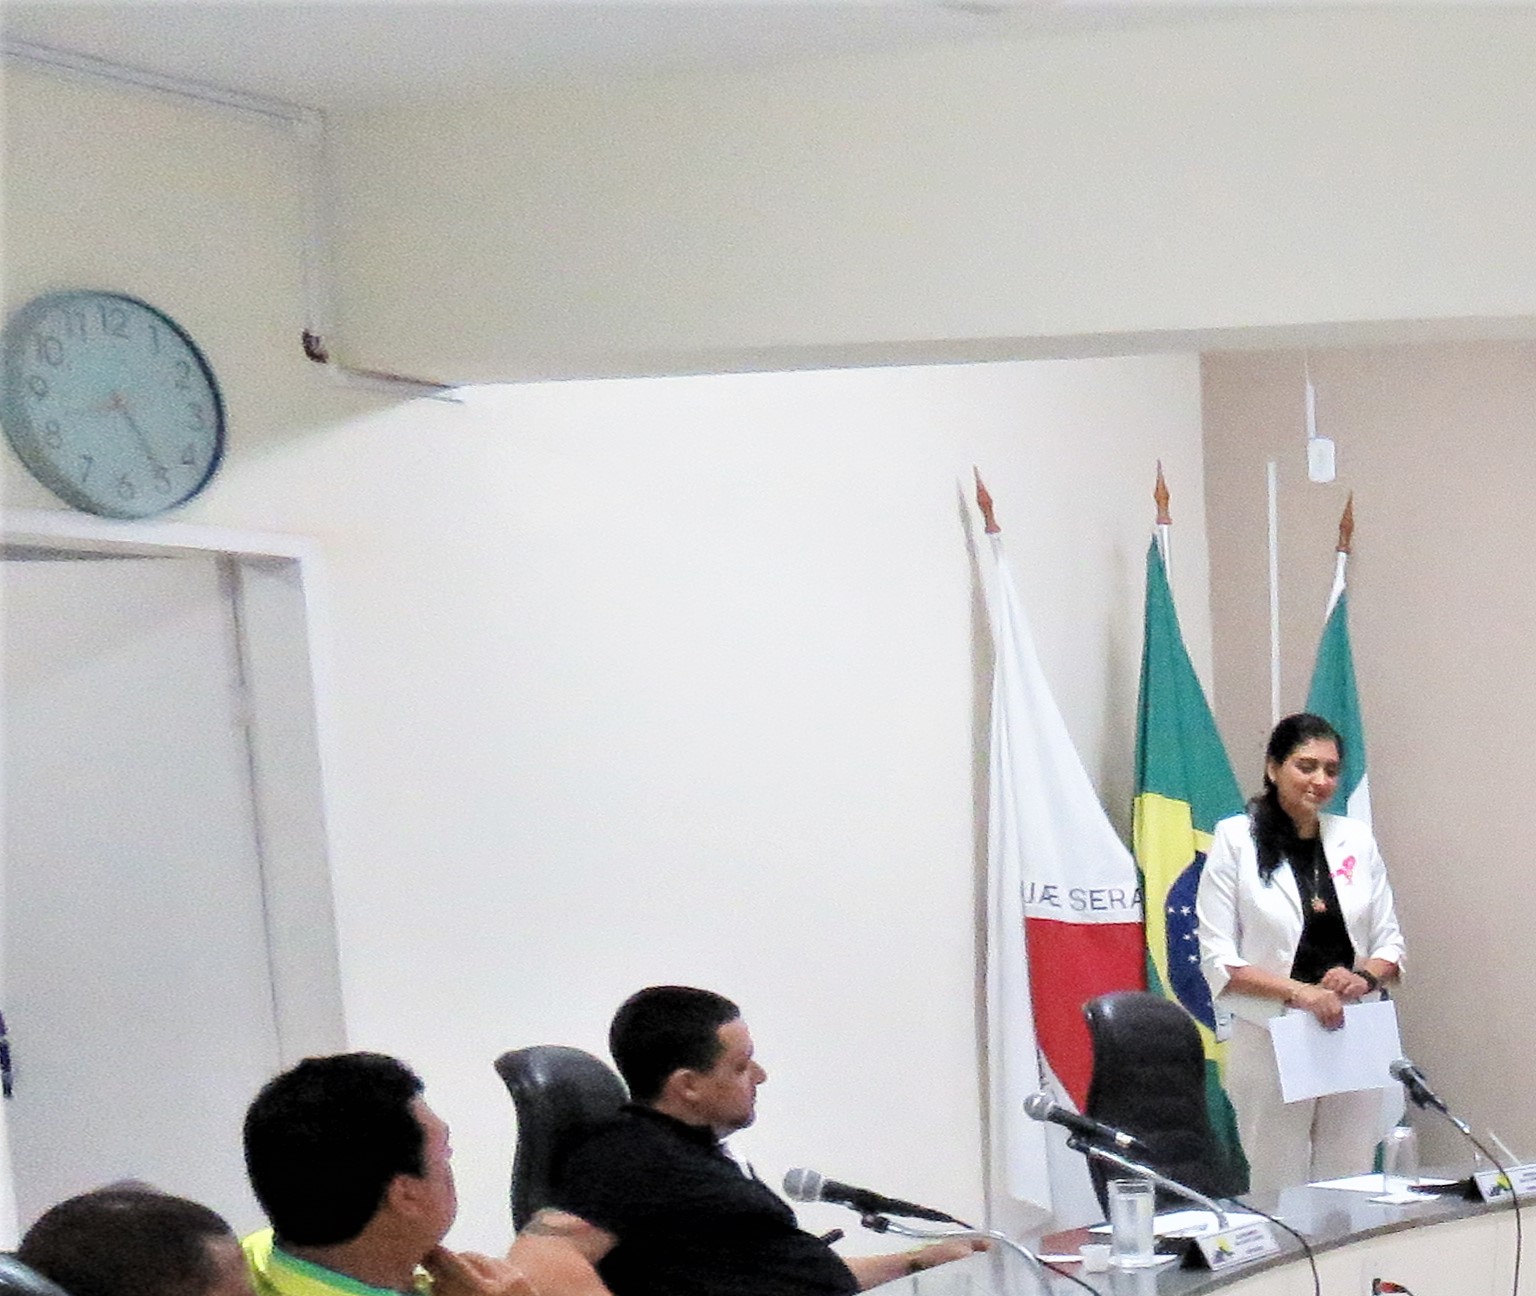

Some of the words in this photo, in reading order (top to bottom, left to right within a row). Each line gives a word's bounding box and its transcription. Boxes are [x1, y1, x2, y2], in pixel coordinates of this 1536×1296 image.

[101, 303, 129, 339] 12
[37, 335, 64, 366] 10
[150, 324, 160, 353] 1
[29, 376, 48, 400] 9
[174, 360, 191, 389] 2
[187, 402, 206, 432] 3
[46, 421, 62, 449] 8
[81, 454, 94, 482] 7
[181, 442, 198, 468] 4
[118, 474, 135, 499] 6
[155, 465, 172, 494] 5
